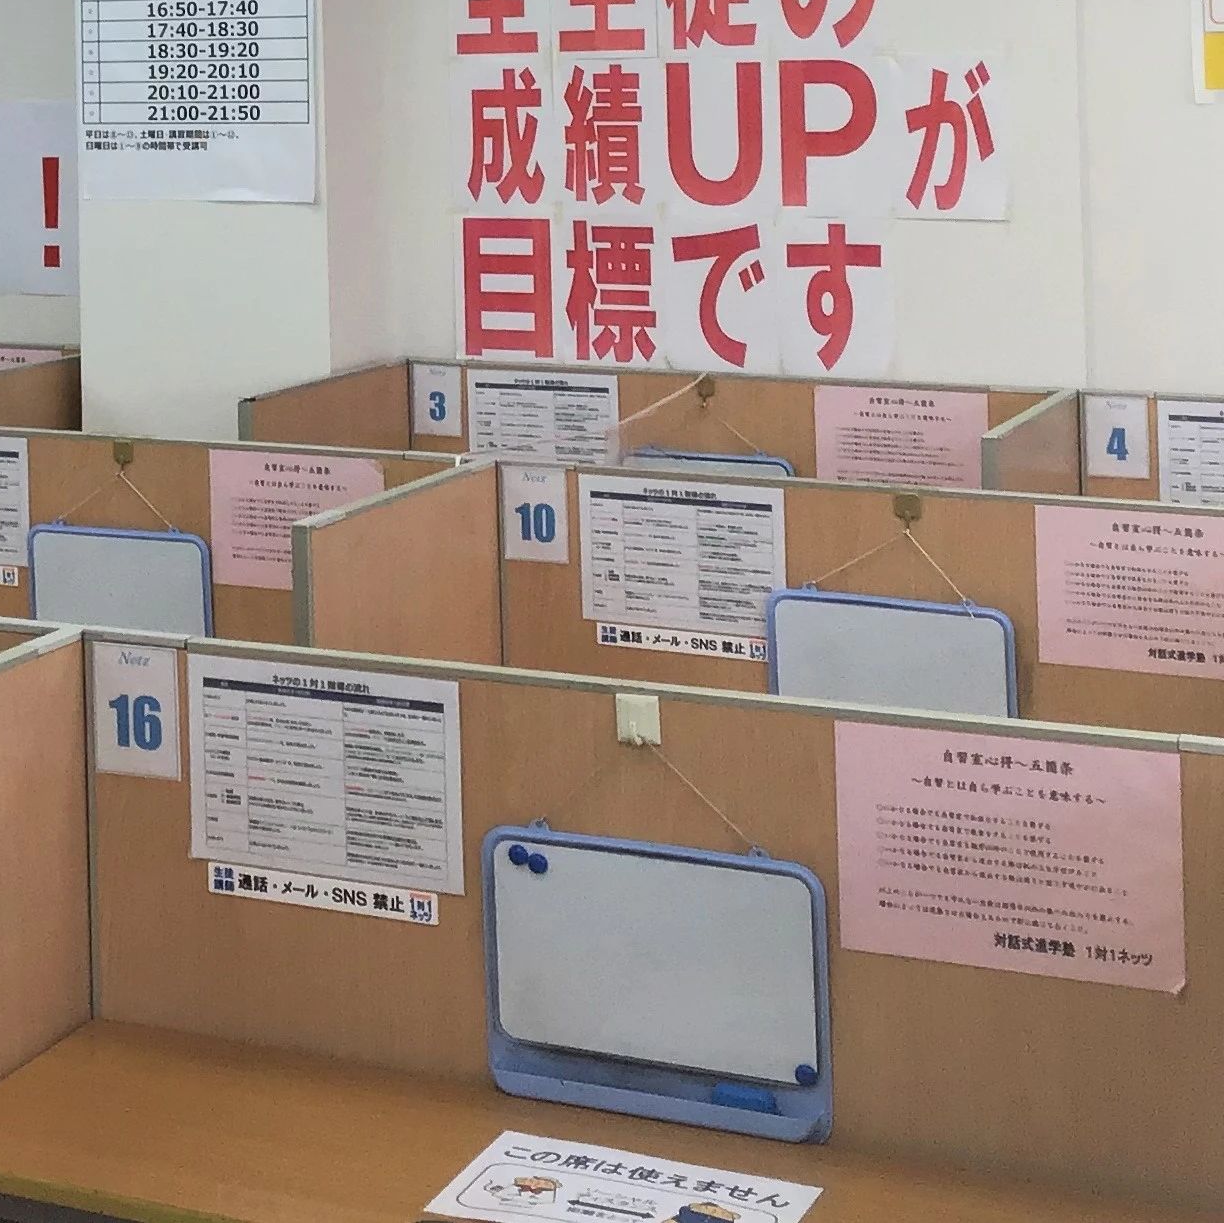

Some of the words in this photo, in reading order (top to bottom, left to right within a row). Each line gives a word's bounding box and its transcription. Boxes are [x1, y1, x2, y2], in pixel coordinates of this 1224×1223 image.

[147, 1, 258, 17] 16:50-17:40
[147, 22, 259, 38] 17:40-18:30
[147, 43, 259, 59] 18:30-19:20
[148, 64, 260, 79] 19:20-20:10
[147, 85, 260, 100] 20:10-21:00
[147, 106, 261, 121] 21:00-21:50
[466, 59, 996, 210] 成績UPが
[462, 217, 882, 371] 目標です
[429, 391, 446, 422] 3
[1106, 428, 1129, 460] 4
[515, 502, 556, 543] 10
[109, 694, 163, 751] 16
[373, 893, 405, 913] 禁止
[504, 1145, 791, 1209] この席は使えません
